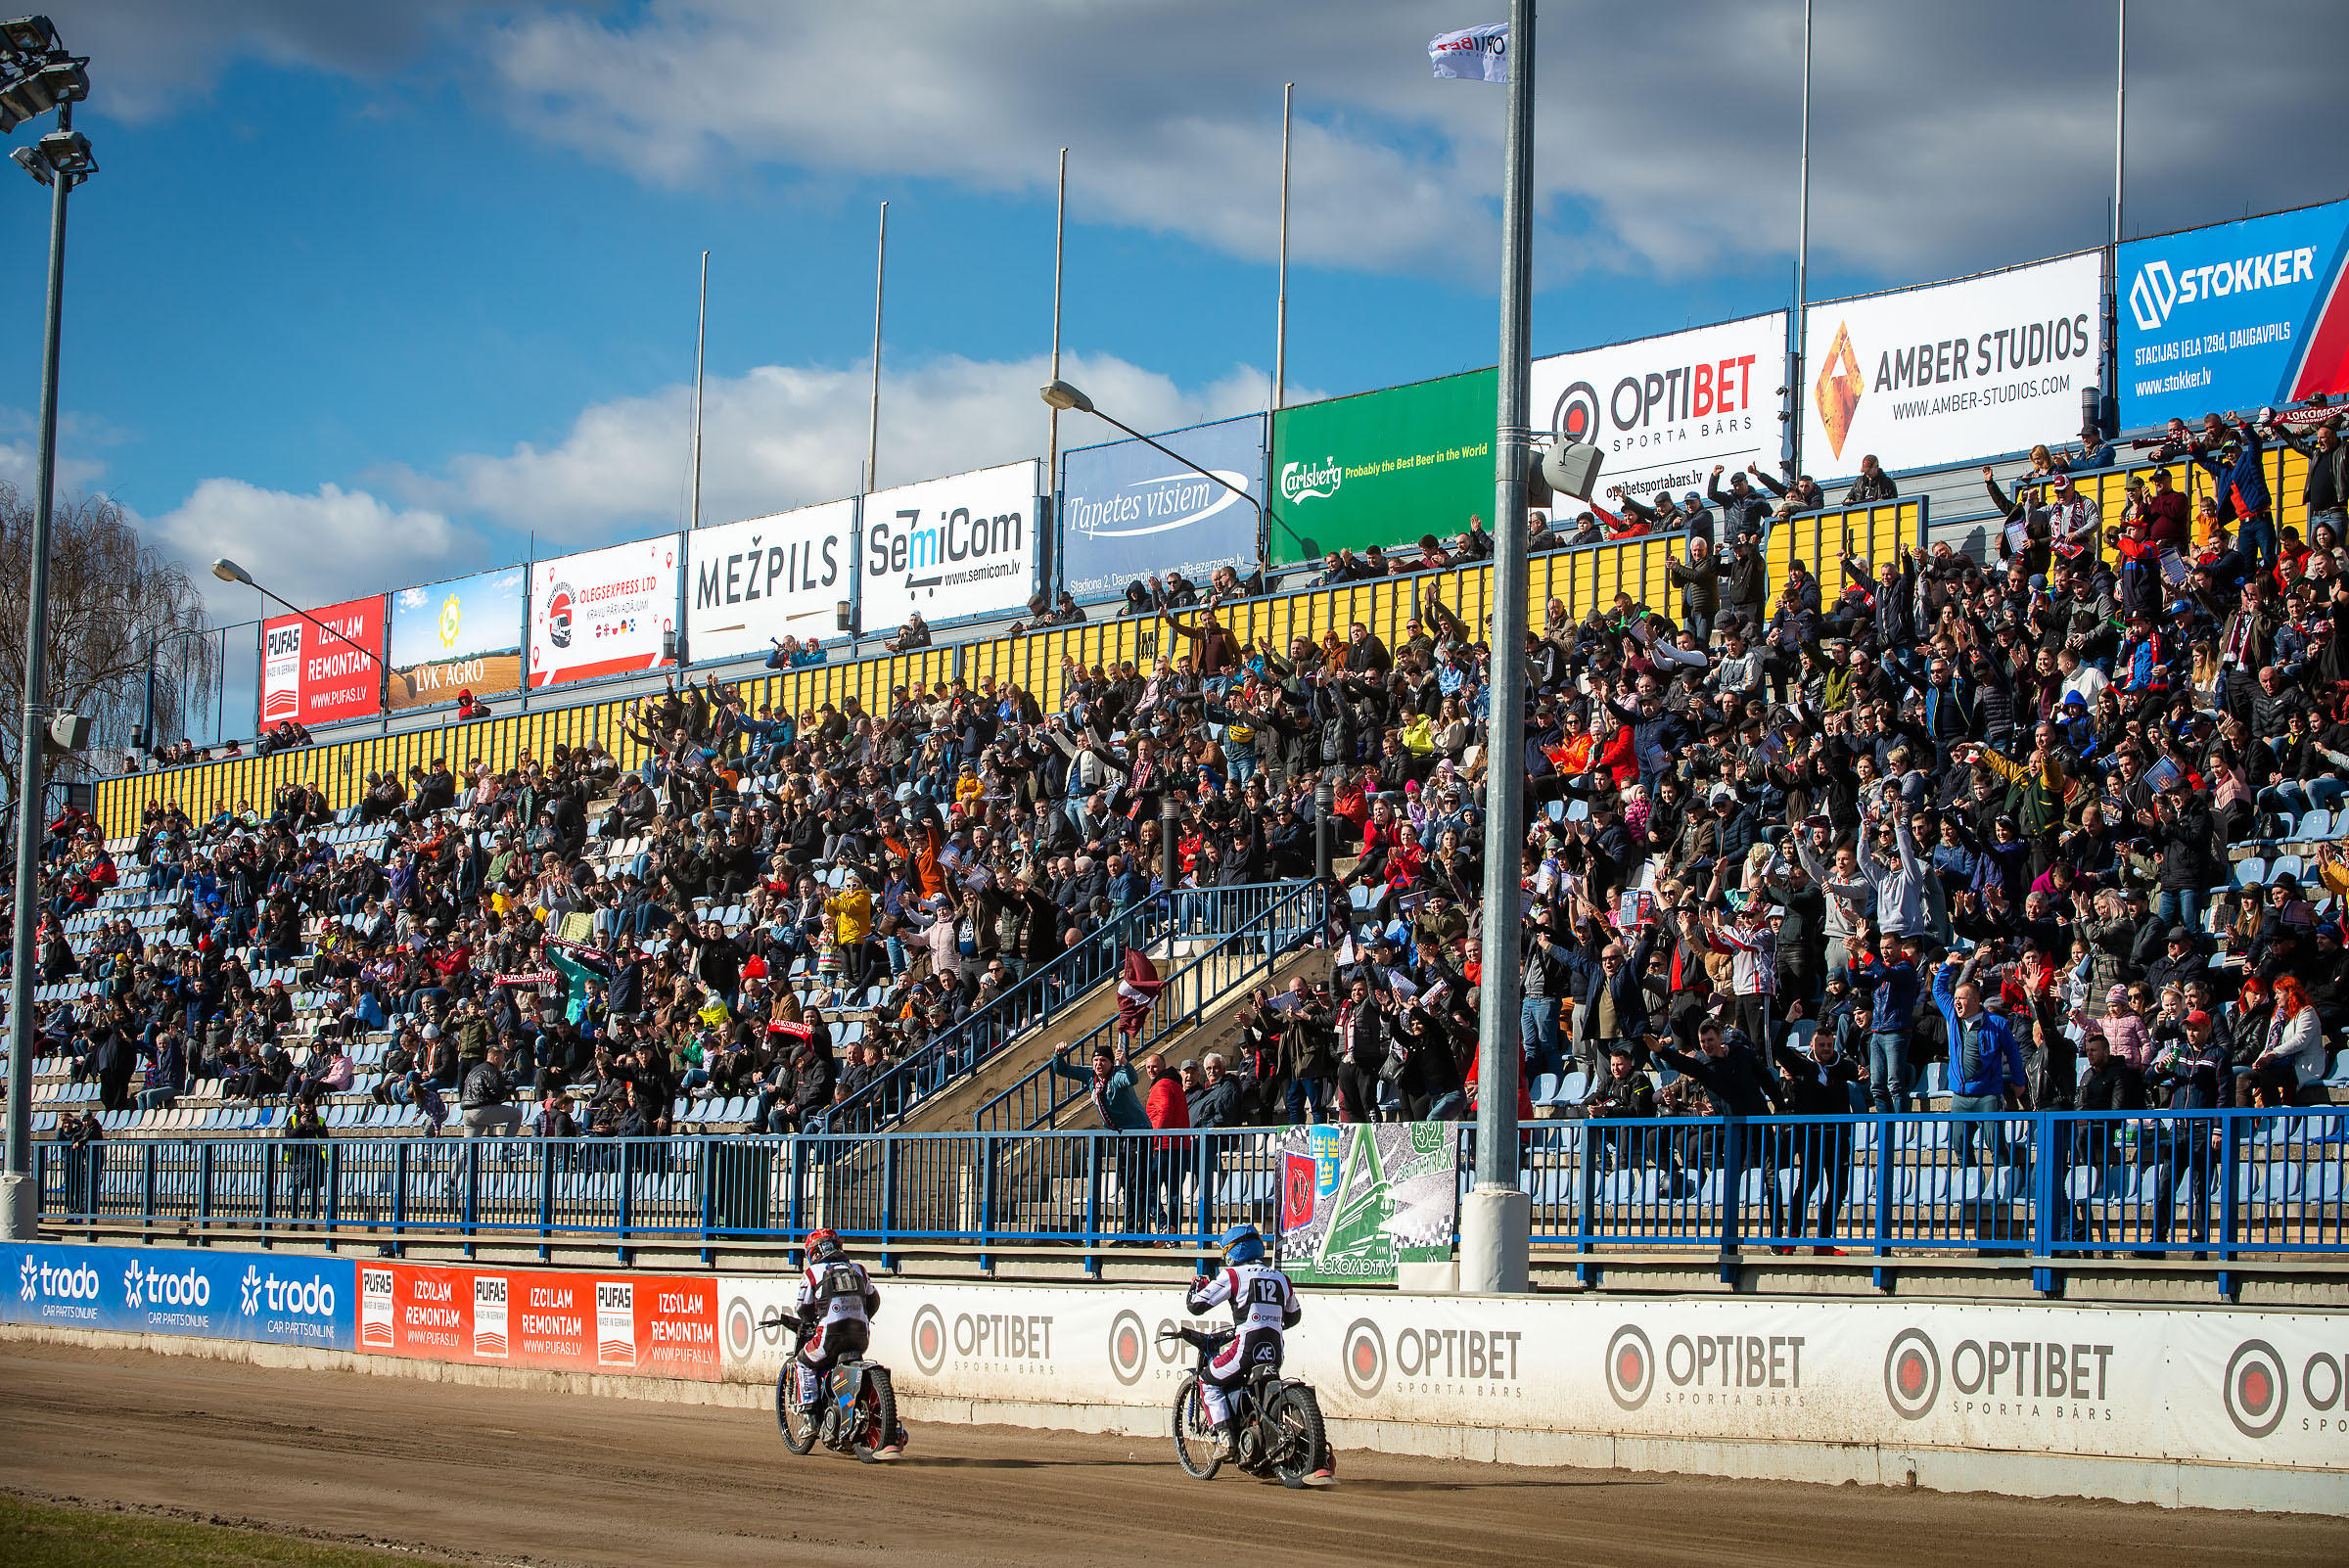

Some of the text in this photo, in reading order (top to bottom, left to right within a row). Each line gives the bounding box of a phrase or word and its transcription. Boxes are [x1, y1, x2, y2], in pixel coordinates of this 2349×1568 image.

[2178, 247, 2314, 304] STOKKER
[1874, 313, 2089, 393] AMBER STUDIOS
[2135, 321, 2291, 367] STACIJAS IELA 129d, DAUGAVPILS
[1610, 354, 1756, 431] OPTIBET
[2135, 366, 2212, 397] www.stokker.lv
[1892, 374, 2071, 421] WWW.AMBER-STUDIOS.COM
[1613, 416, 1752, 452] SPORTA BĀRS
[1280, 442, 1488, 500] Carlsberg Probably the Best Beer in the World
[1606, 469, 1703, 501] opibetsportabars.lv
[1070, 482, 1211, 540] Tapetes visiem
[869, 507, 1022, 576] SemiCom
[697, 534, 838, 610] MEŽPILS
[944, 559, 1021, 586] www.semicom.lv
[1070, 578, 1102, 594] Stadiona
[1103, 577, 1112, 589] 2,
[579, 576, 657, 604] OLEGSEXPRESS LTD
[267, 628, 299, 657] PUFAS
[307, 648, 372, 681] REMONTAM
[416, 658, 484, 692] LVK AGRO
[310, 685, 367, 709] WWW.PUFAS.LV
[1415, 1122, 1441, 1148] 52
[1428, 1144, 1453, 1175] TRACK
[40, 1261, 100, 1299] trodo
[146, 1266, 210, 1307] trodo
[363, 1272, 392, 1293] PUFAS
[414, 1280, 452, 1302] IZCILAM
[476, 1280, 506, 1302] PUFAS
[1257, 1279, 1277, 1303] 12
[264, 1272, 335, 1316] trodo
[530, 1287, 574, 1309] IZCILAM
[598, 1287, 631, 1308] PUFAS
[659, 1293, 703, 1314] IZCILAM
[42, 1305, 97, 1319] CAR PARTS ONLINE
[148, 1312, 208, 1328] CAR PARTS ONLINE
[405, 1306, 460, 1328] REMONTAM
[522, 1314, 582, 1336] REMONTAM
[267, 1320, 335, 1339] CAR PARTS ONLINE
[407, 1329, 459, 1347] WWW.PUFAS.LV
[651, 1320, 714, 1344] REMONTAM
[953, 1312, 1054, 1360] OPTIBET
[523, 1339, 582, 1356] WWW.PUFAS.LV
[651, 1346, 714, 1363] WWW.PUFAS.LV
[1396, 1327, 1522, 1380] OPTIBET
[954, 1360, 1055, 1375] SPORTA BĀRS
[1666, 1334, 1805, 1389] OPTIBET
[1952, 1339, 2114, 1401] OPTIBET
[1397, 1381, 1522, 1399] SPORTA BĀRS
[1666, 1391, 1805, 1407] SPORTA BĀRS
[1953, 1401, 2112, 1421] SPORTA BĀRS
